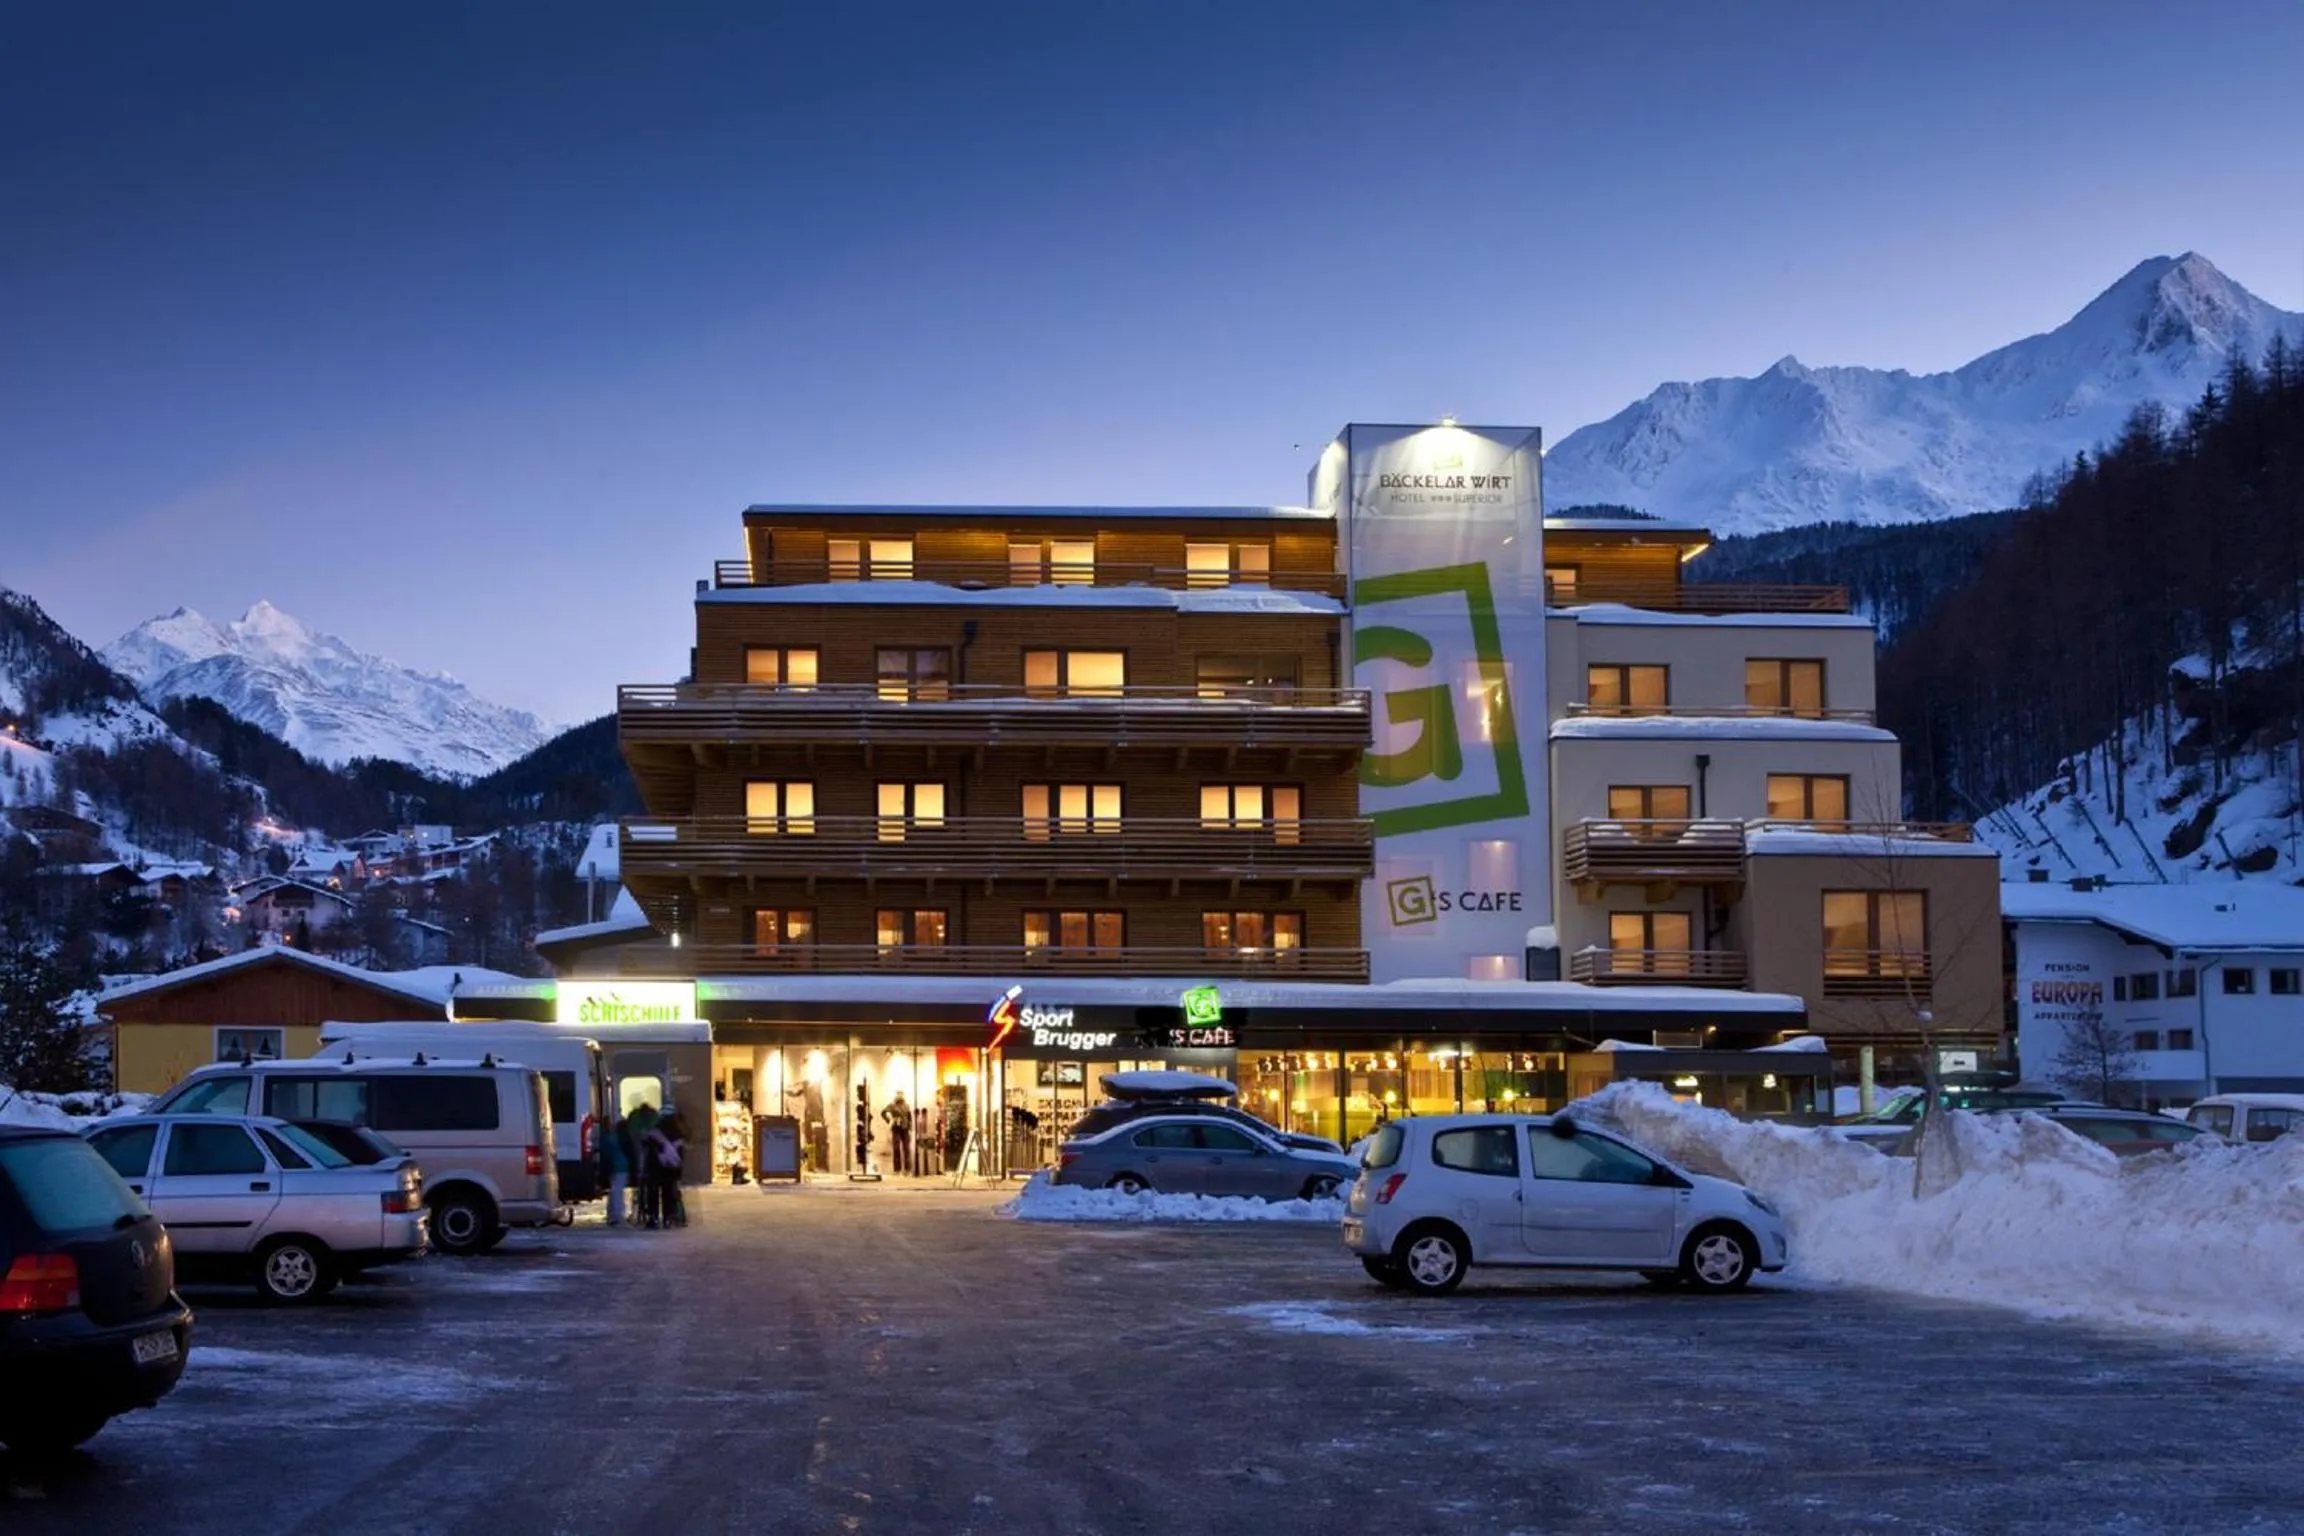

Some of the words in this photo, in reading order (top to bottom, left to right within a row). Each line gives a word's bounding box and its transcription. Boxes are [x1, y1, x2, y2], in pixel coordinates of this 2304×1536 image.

[1380, 472, 1466, 489] BÄCKELAR
[1391, 493, 1425, 503] HOTEL
[1459, 891, 1523, 912] CAFE
[2044, 963, 2090, 973] PENSION
[2032, 981, 2104, 1005] EUROPA
[1019, 1008, 1075, 1031] Sport
[1033, 1028, 1117, 1050] Brugger
